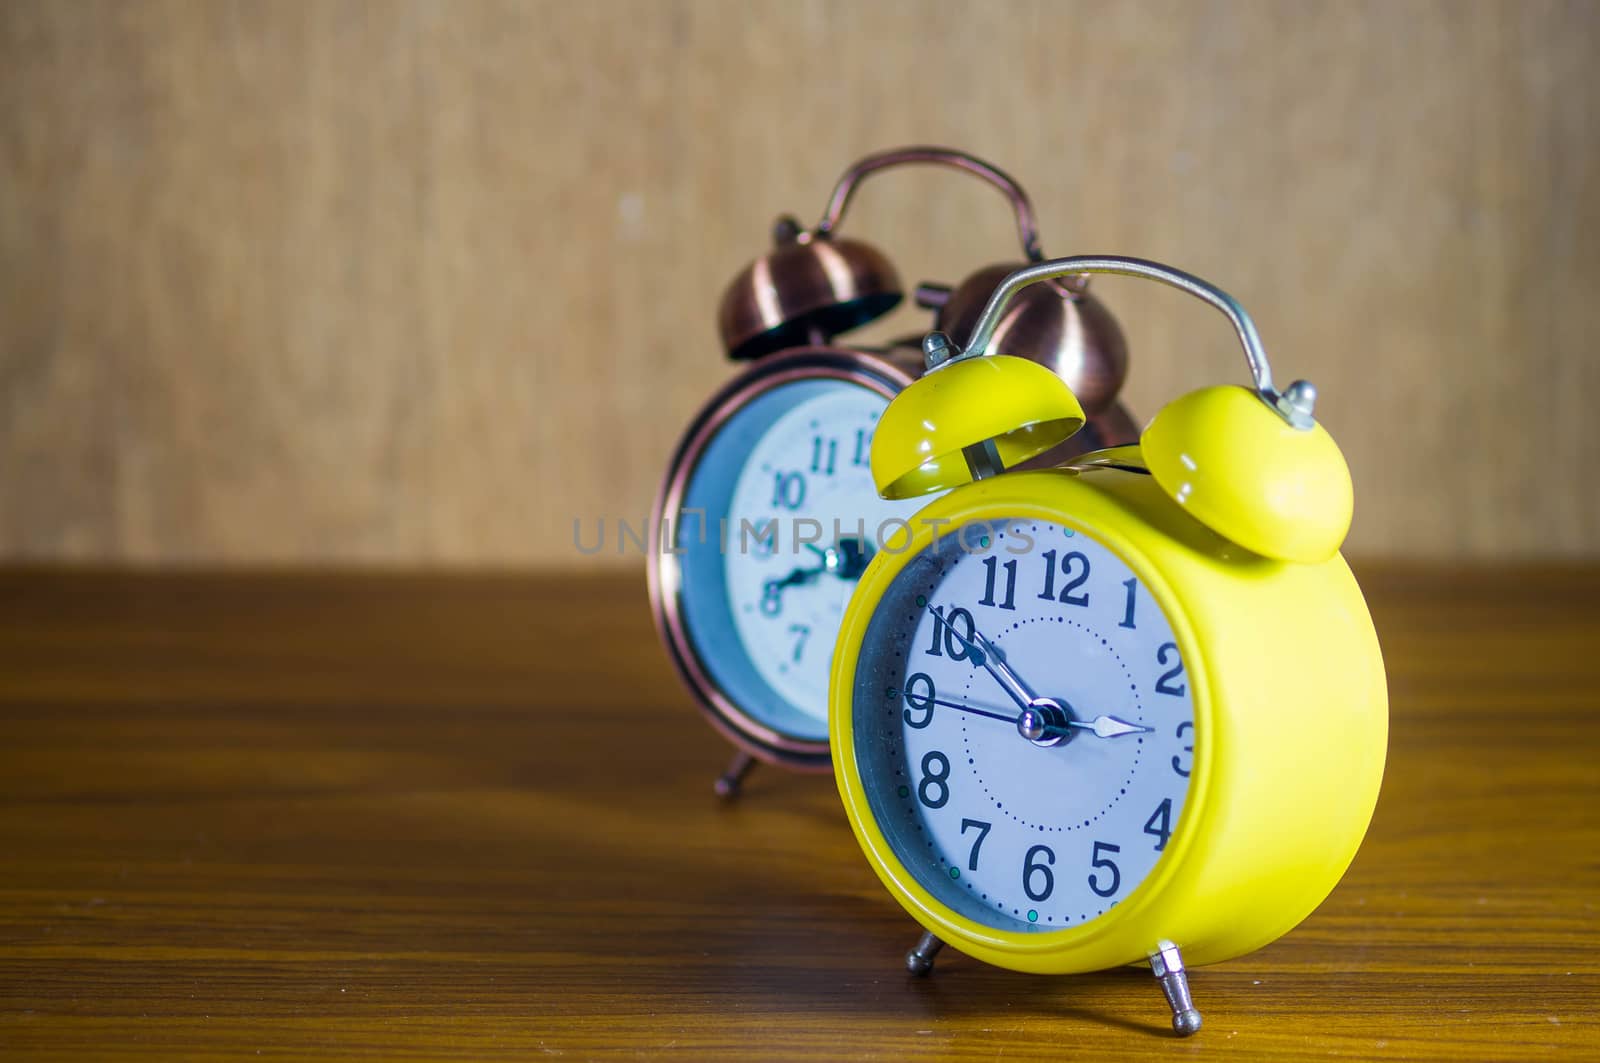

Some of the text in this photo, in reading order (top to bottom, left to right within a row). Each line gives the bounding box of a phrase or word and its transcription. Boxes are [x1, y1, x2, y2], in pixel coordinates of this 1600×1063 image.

[810, 436, 837, 475] 11
[853, 429, 872, 467] 1
[772, 470, 806, 510] 10
[978, 555, 1017, 610] 11
[1037, 549, 1091, 607] 12
[1118, 577, 1138, 629] 1
[788, 624, 811, 662] 7
[925, 605, 975, 661] 10
[1155, 642, 1185, 696] 2
[903, 672, 936, 729] 9
[1172, 721, 1195, 777] 3
[918, 751, 950, 809] 8
[961, 818, 991, 871] 7
[1144, 798, 1172, 852] 4
[1023, 844, 1055, 901] 6
[1088, 841, 1121, 897] 5
